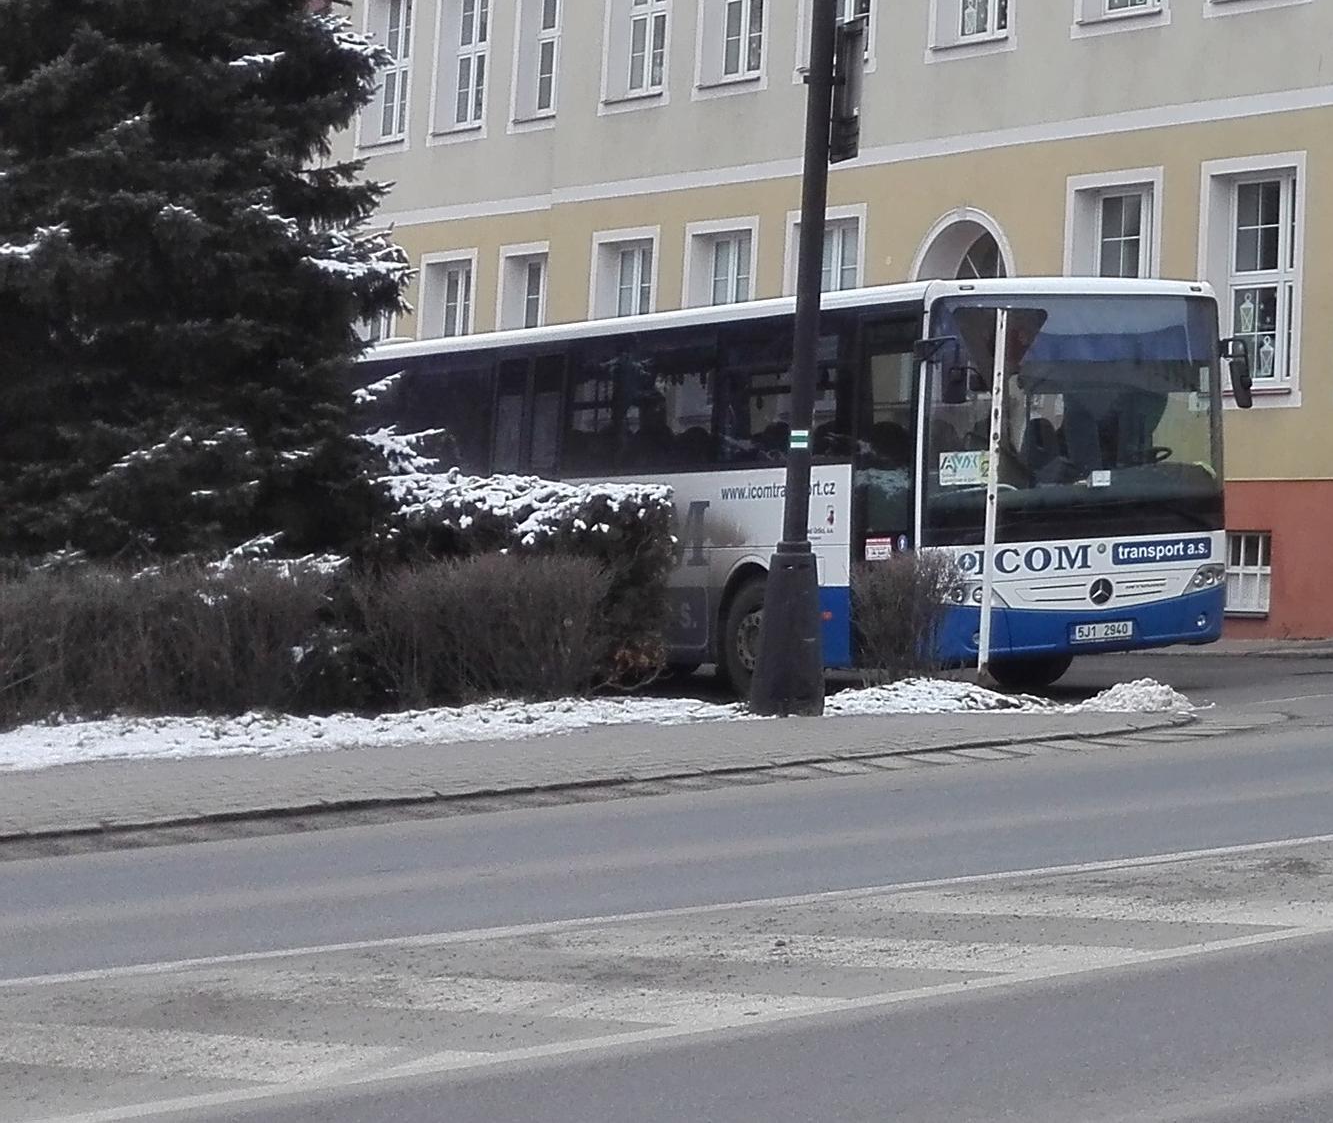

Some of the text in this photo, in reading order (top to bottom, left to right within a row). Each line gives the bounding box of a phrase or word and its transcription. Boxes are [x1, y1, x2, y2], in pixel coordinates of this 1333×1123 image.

[721, 481, 836, 500] www.icomtrart.cz
[1118, 541, 1184, 560] transport
[1187, 542, 1208, 555] a.s.
[1078, 623, 1128, 638] 5J1 2940
